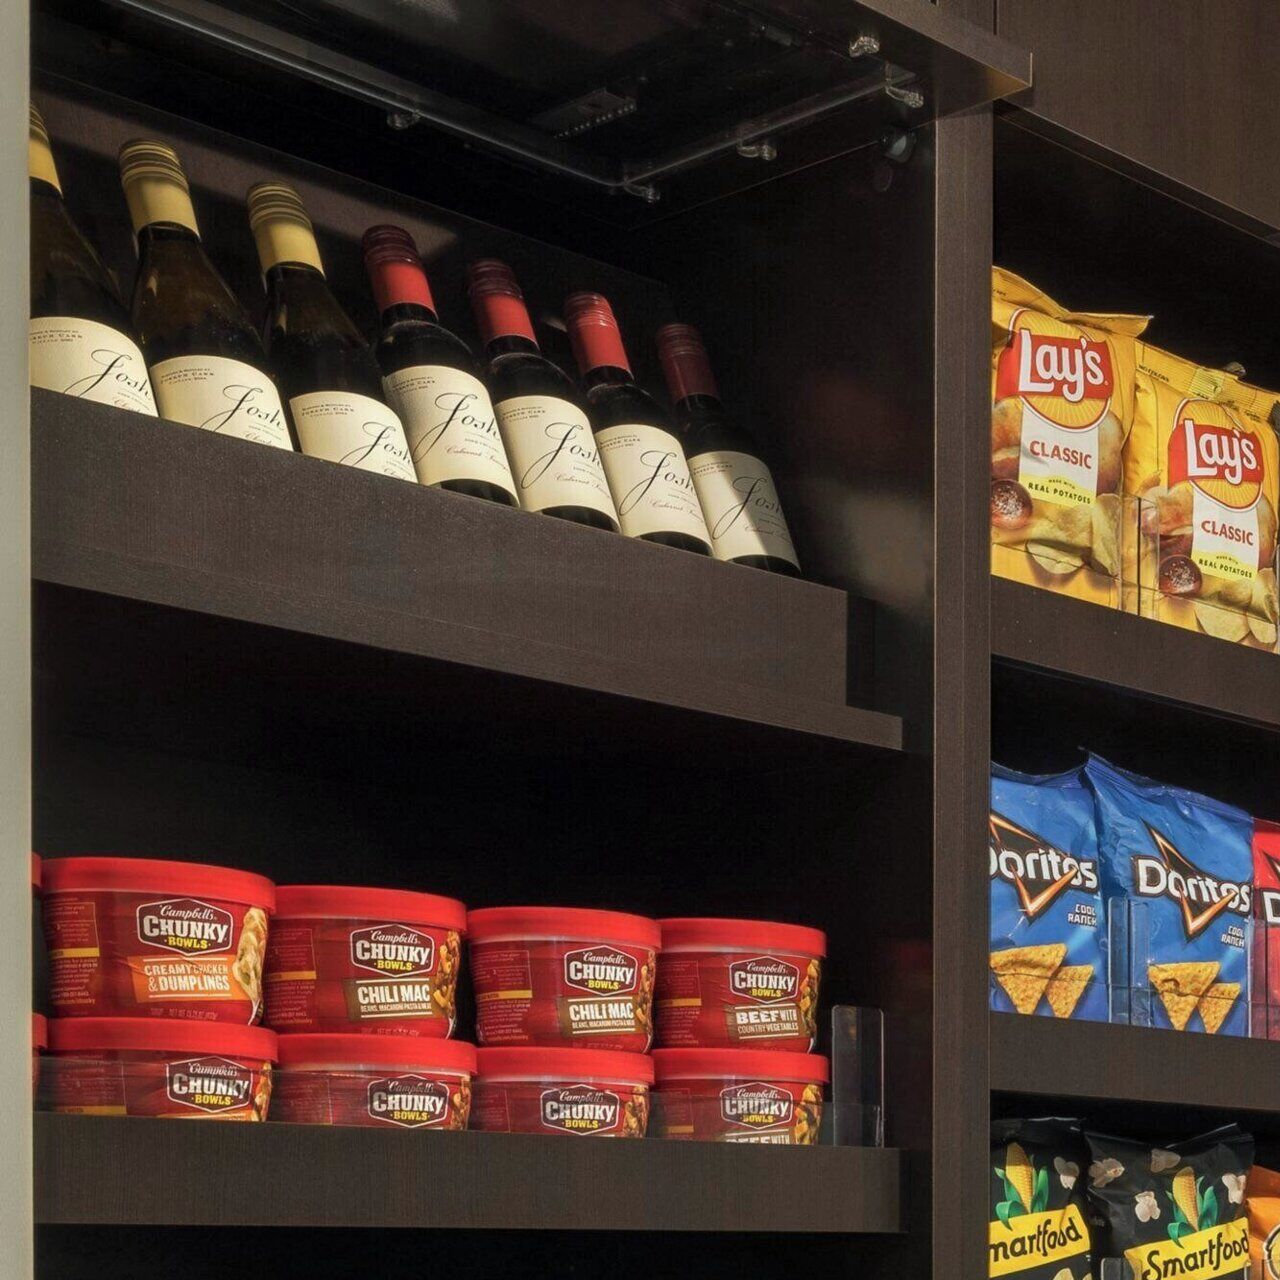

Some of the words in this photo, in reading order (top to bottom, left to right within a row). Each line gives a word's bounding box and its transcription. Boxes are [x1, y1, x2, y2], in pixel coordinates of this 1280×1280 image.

[1018, 328, 1105, 403] Lay's
[200, 384, 286, 433] Josh
[413, 392, 501, 464] Josh
[521, 422, 602, 490] Josh
[1029, 439, 1092, 470] CLASSIC
[1184, 419, 1258, 485] Lay's
[618, 450, 694, 516] Josh
[1028, 482, 1050, 493] REAL
[1053, 487, 1091, 505] POTATOES
[1201, 519, 1254, 546] CLASSIC
[1199, 558, 1218, 568] REAL
[1220, 563, 1253, 578] POTATOES
[1138, 858, 1250, 913] Doritos
[159, 903, 218, 921] Campbell's
[1074, 903, 1096, 916] COOL
[142, 915, 229, 943] CHUNKY
[1067, 913, 1098, 927] RANCH
[371, 930, 421, 945] Campbell's
[1228, 925, 1245, 938] COOL
[167, 935, 208, 950] BOWLS
[355, 940, 432, 967] CHUNKY
[582, 952, 628, 966] Campbell's
[376, 959, 413, 972] BOWLS
[568, 961, 636, 985] CHUNKY
[745, 962, 789, 976] Campbell's
[148, 976, 158, 993] &
[158, 973, 231, 992] DUMPLINGS
[587, 979, 620, 991] BOWLS
[733, 972, 798, 993] CHUNKY
[750, 986, 783, 998] BOWLS
[357, 985, 400, 1005] CHILI
[400, 984, 431, 1002] MAC
[569, 1003, 607, 1021] CHILI
[607, 1002, 634, 1021] MAC
[735, 1010, 781, 1025] BEEF
[781, 1008, 798, 1023] WITH
[171, 1073, 250, 1099] CHUNKY
[193, 1094, 233, 1107] BOWLS
[371, 1092, 445, 1116] CHUNKY
[725, 1097, 792, 1118] CHUNKY
[393, 1109, 430, 1122] BOWLS
[544, 1100, 616, 1123] CHUNKY
[741, 1113, 775, 1124] BOWLS
[564, 1118, 600, 1130] BOWLS
